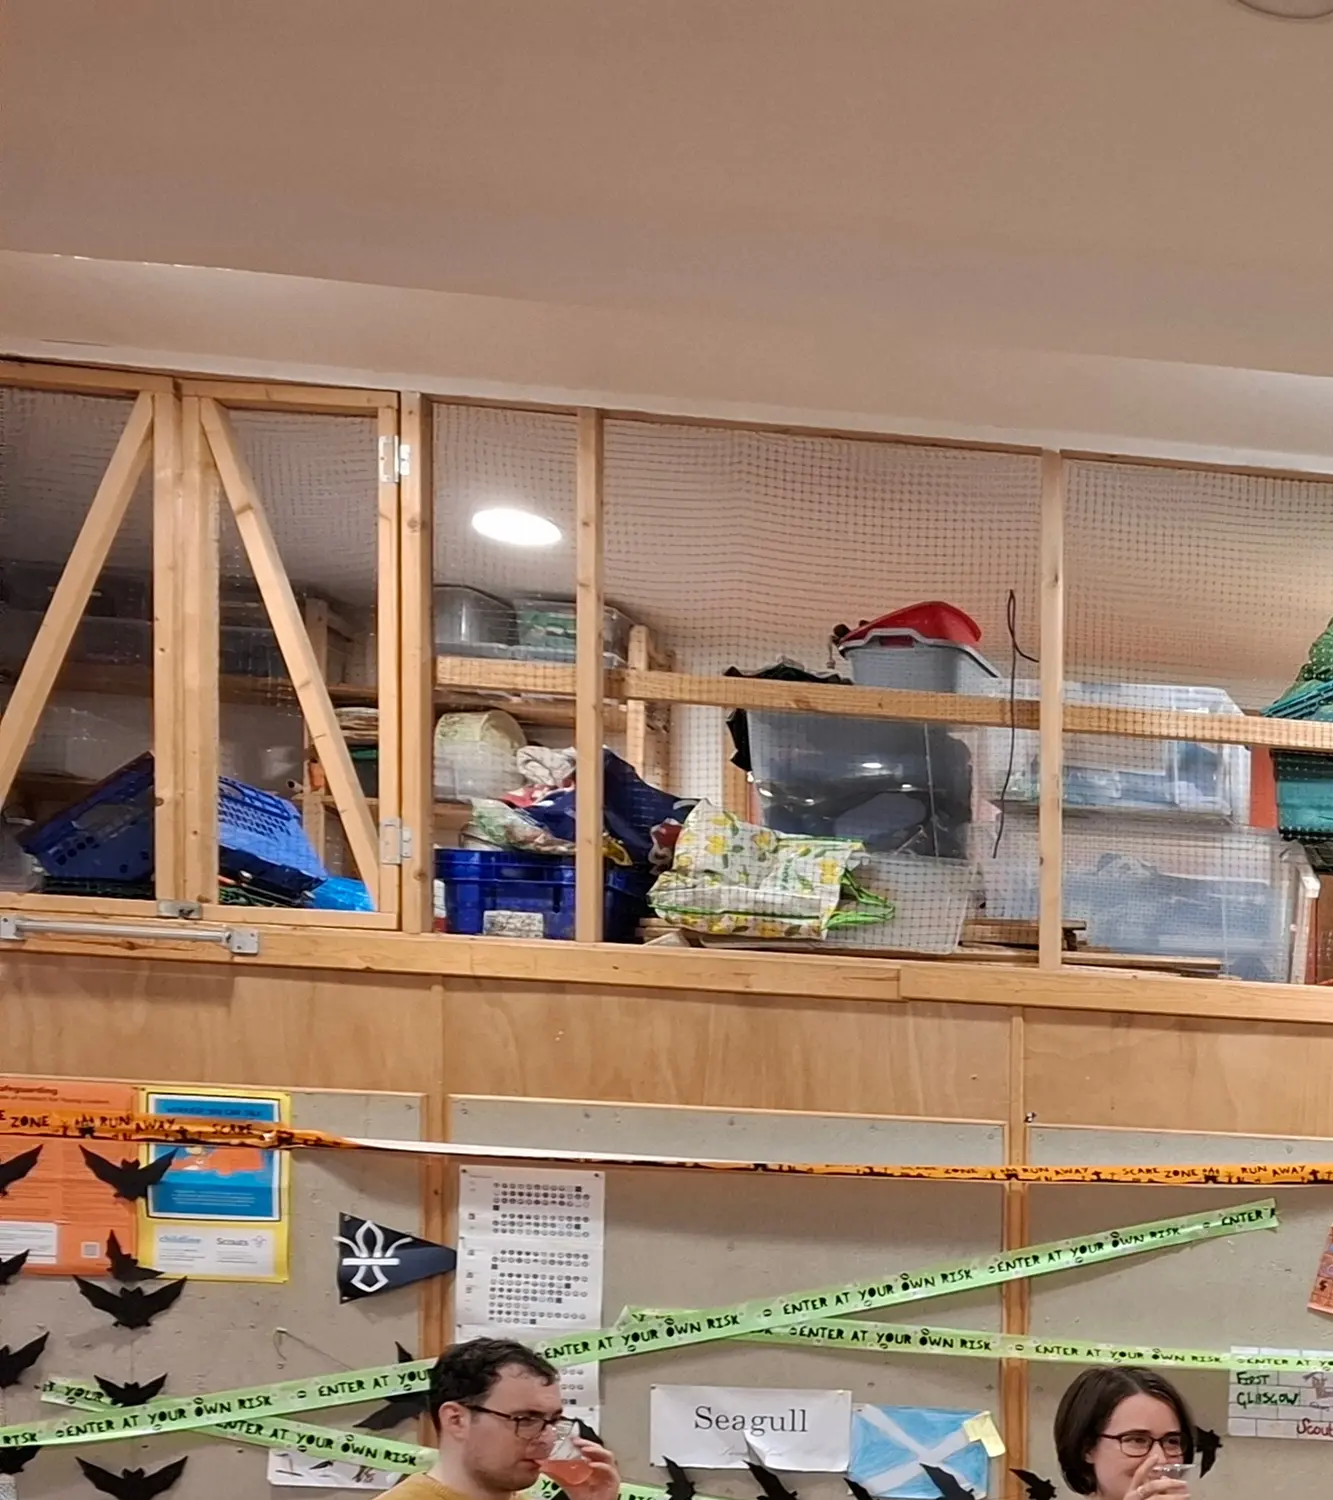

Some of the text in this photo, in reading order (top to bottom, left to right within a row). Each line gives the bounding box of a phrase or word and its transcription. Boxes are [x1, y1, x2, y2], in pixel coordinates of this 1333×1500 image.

[10, 1115, 50, 1128] ZONE
[99, 1114, 131, 1128] RUN
[134, 1117, 176, 1133] AWAY
[1021, 1166, 1050, 1175] RUN
[1054, 1166, 1090, 1177] AWAY
[1122, 1166, 1160, 1176] SCARE
[1163, 1169, 1198, 1179] ZONE
[1240, 1165, 1268, 1175] RUN
[1271, 1164, 1307, 1178] AWAY
[1221, 1210, 1263, 1227] ENTER
[215, 1237, 249, 1247] Scouts
[996, 1226, 1181, 1273] ENTER AT YOUR OWN RISK
[783, 1268, 974, 1316] ENTER AT YOUR OWN RISK
[544, 1314, 740, 1360] ENTER AT YOUR OWN RISK
[798, 1325, 993, 1351] ENTER AT YOUR OWN RISK
[1035, 1343, 1223, 1364] ENTER AT YOUR OWN RISK
[64, 1386, 105, 1401] YOUR
[317, 1378, 366, 1398] ENTER
[372, 1374, 390, 1390] AT
[1236, 1391, 1300, 1409] GLASGOW
[66, 1394, 273, 1437] ENTER AT YOUR OWN RISK
[694, 1405, 808, 1437] Seagull
[271, 1427, 288, 1441] AT
[297, 1433, 334, 1450] YOUR
[341, 1441, 378, 1460] OWN
[383, 1449, 417, 1467] RISK
